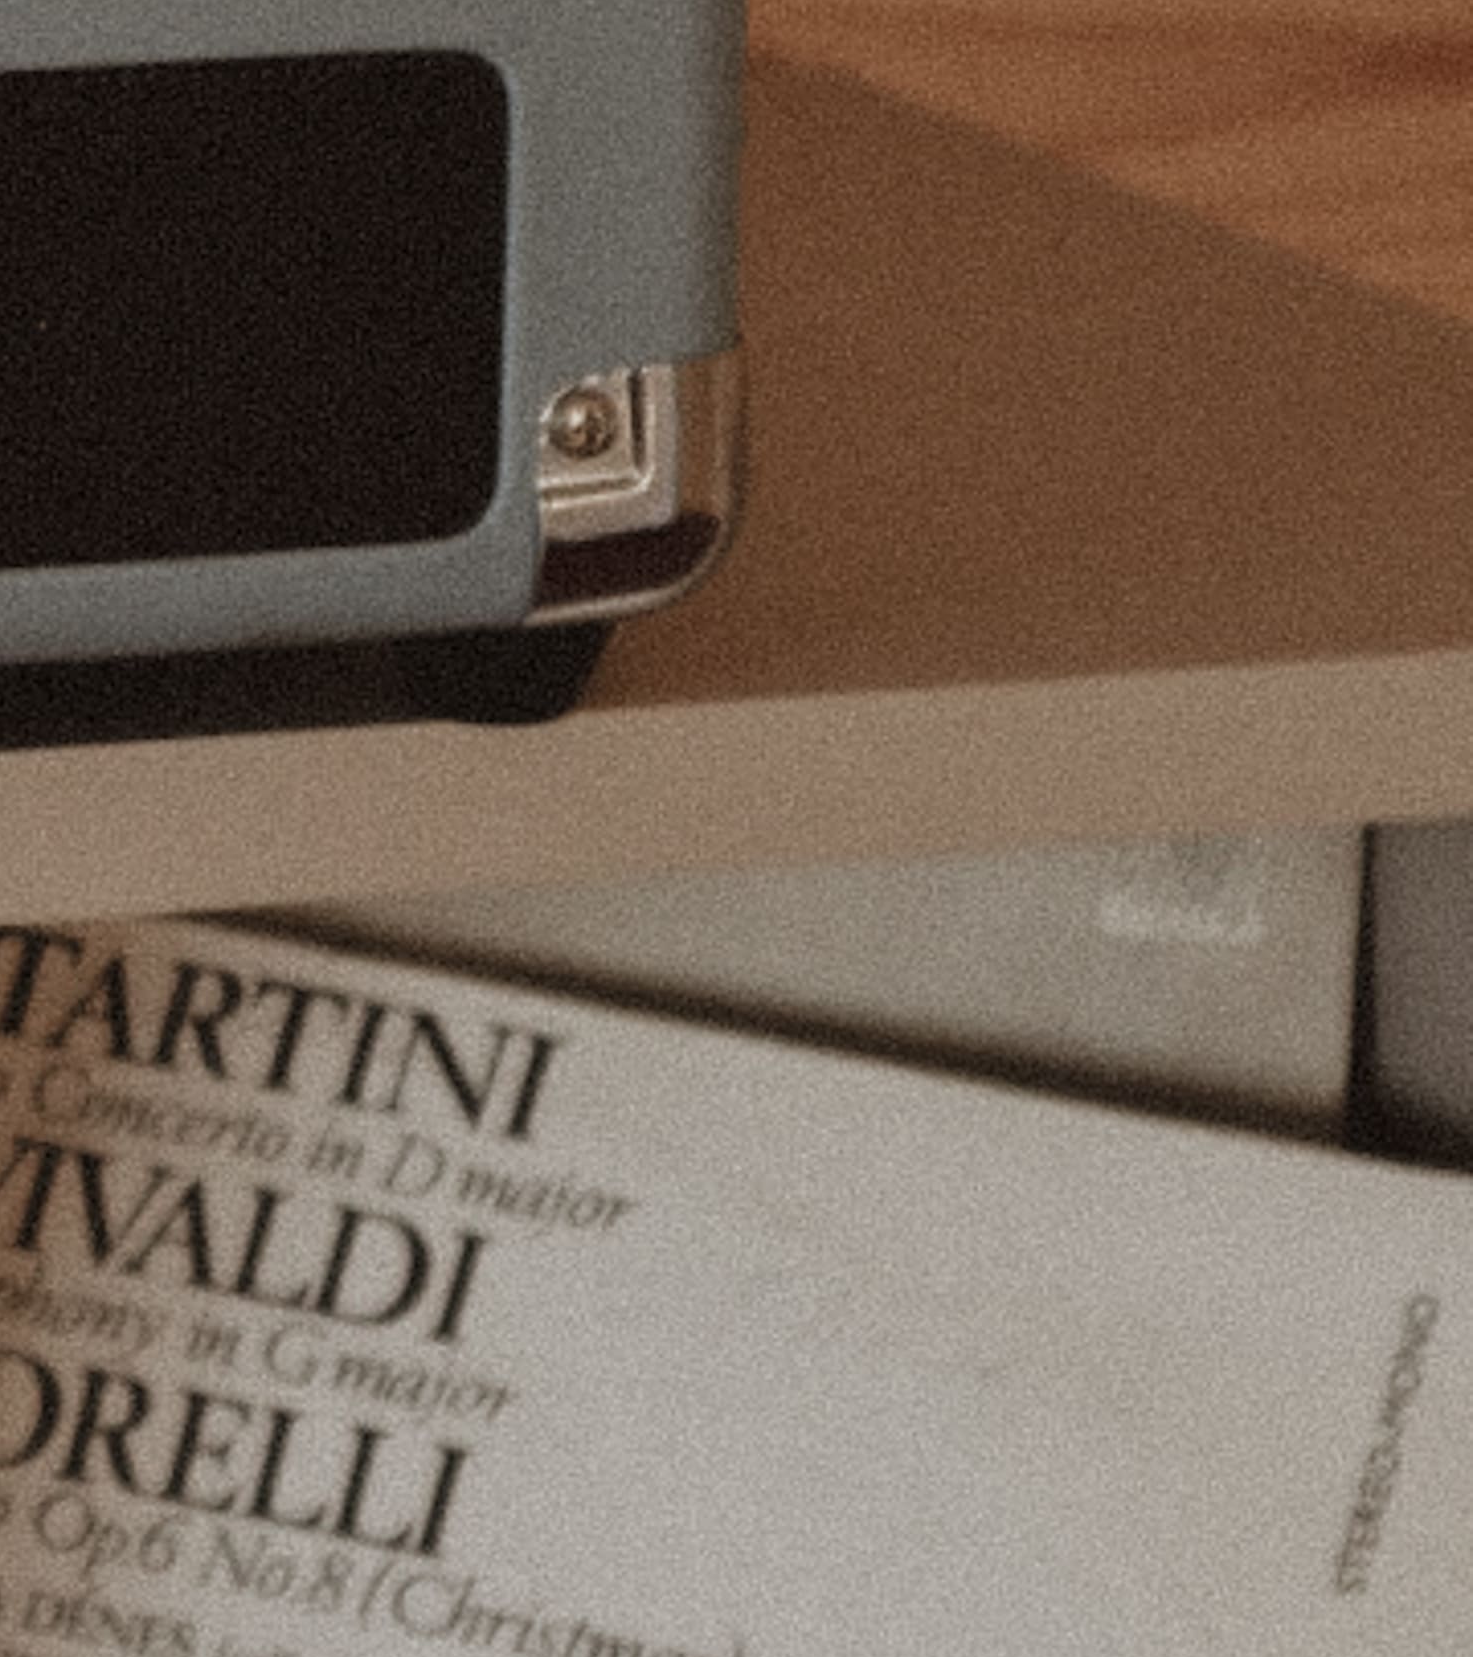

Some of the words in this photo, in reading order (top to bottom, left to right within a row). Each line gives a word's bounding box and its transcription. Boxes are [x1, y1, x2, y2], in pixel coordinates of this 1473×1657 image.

[32, 1059, 292, 1164] Concerto
[306, 1123, 366, 1180] in
[382, 1132, 450, 1198] D
[457, 1163, 640, 1238] major
[184, 1311, 242, 1370] in
[260, 1321, 322, 1388] G
[330, 1350, 518, 1428] major
